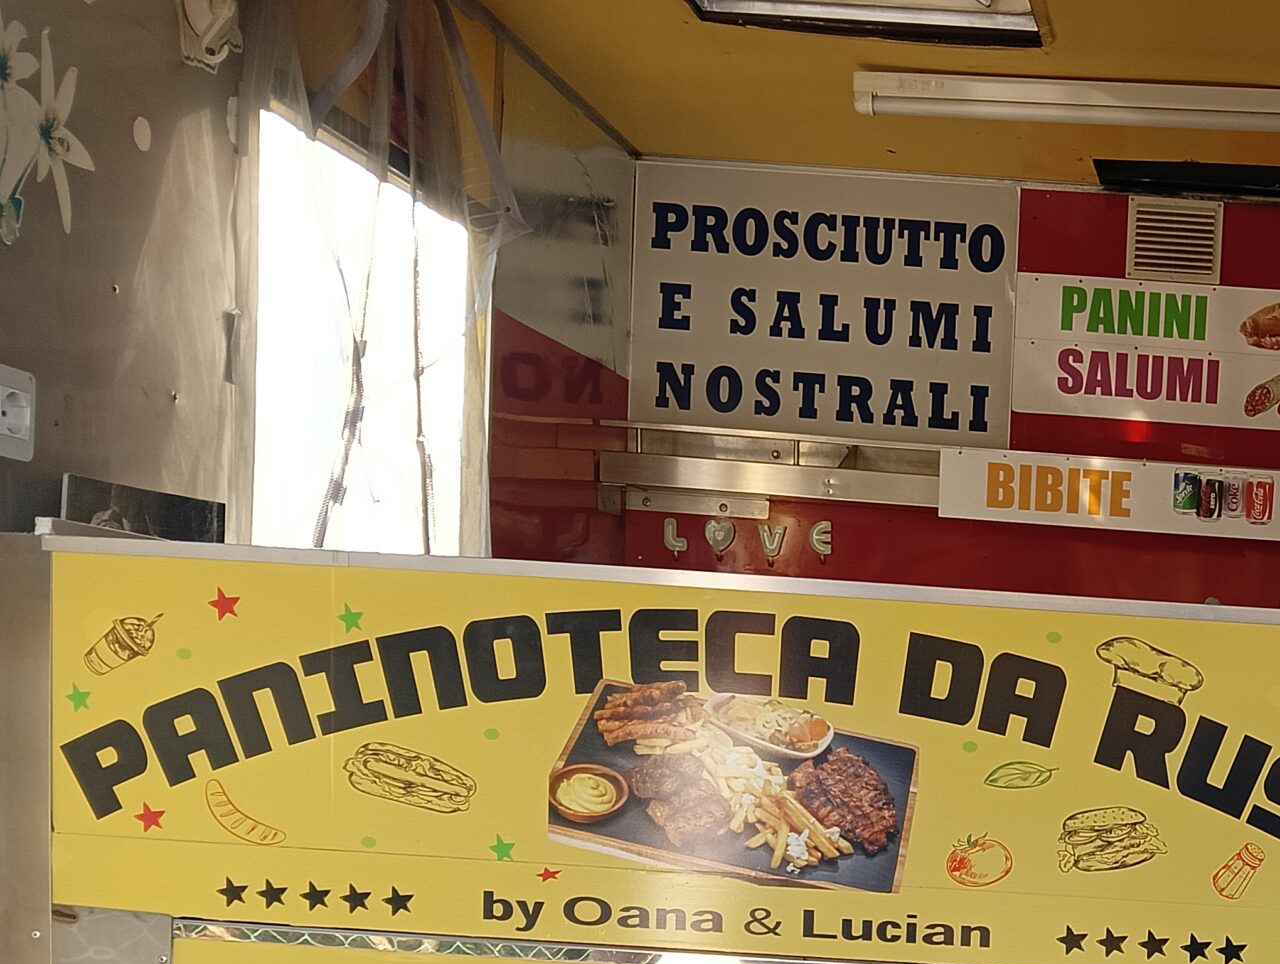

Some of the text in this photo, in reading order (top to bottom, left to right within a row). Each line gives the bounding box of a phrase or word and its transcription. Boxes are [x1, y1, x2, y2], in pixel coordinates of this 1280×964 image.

[649, 200, 1006, 274] PROSCIUTTO
[657, 281, 994, 354] E SALUMI
[1059, 284, 1209, 342] PANINI
[653, 360, 991, 434] NOSTRALI
[1056, 346, 1221, 405] SALUMI
[985, 461, 1133, 518] BIBITE
[59, 608, 862, 821] PANINOTECA
[897, 631, 1068, 749] DA
[481, 890, 992, 949] by Oana & Lucian
